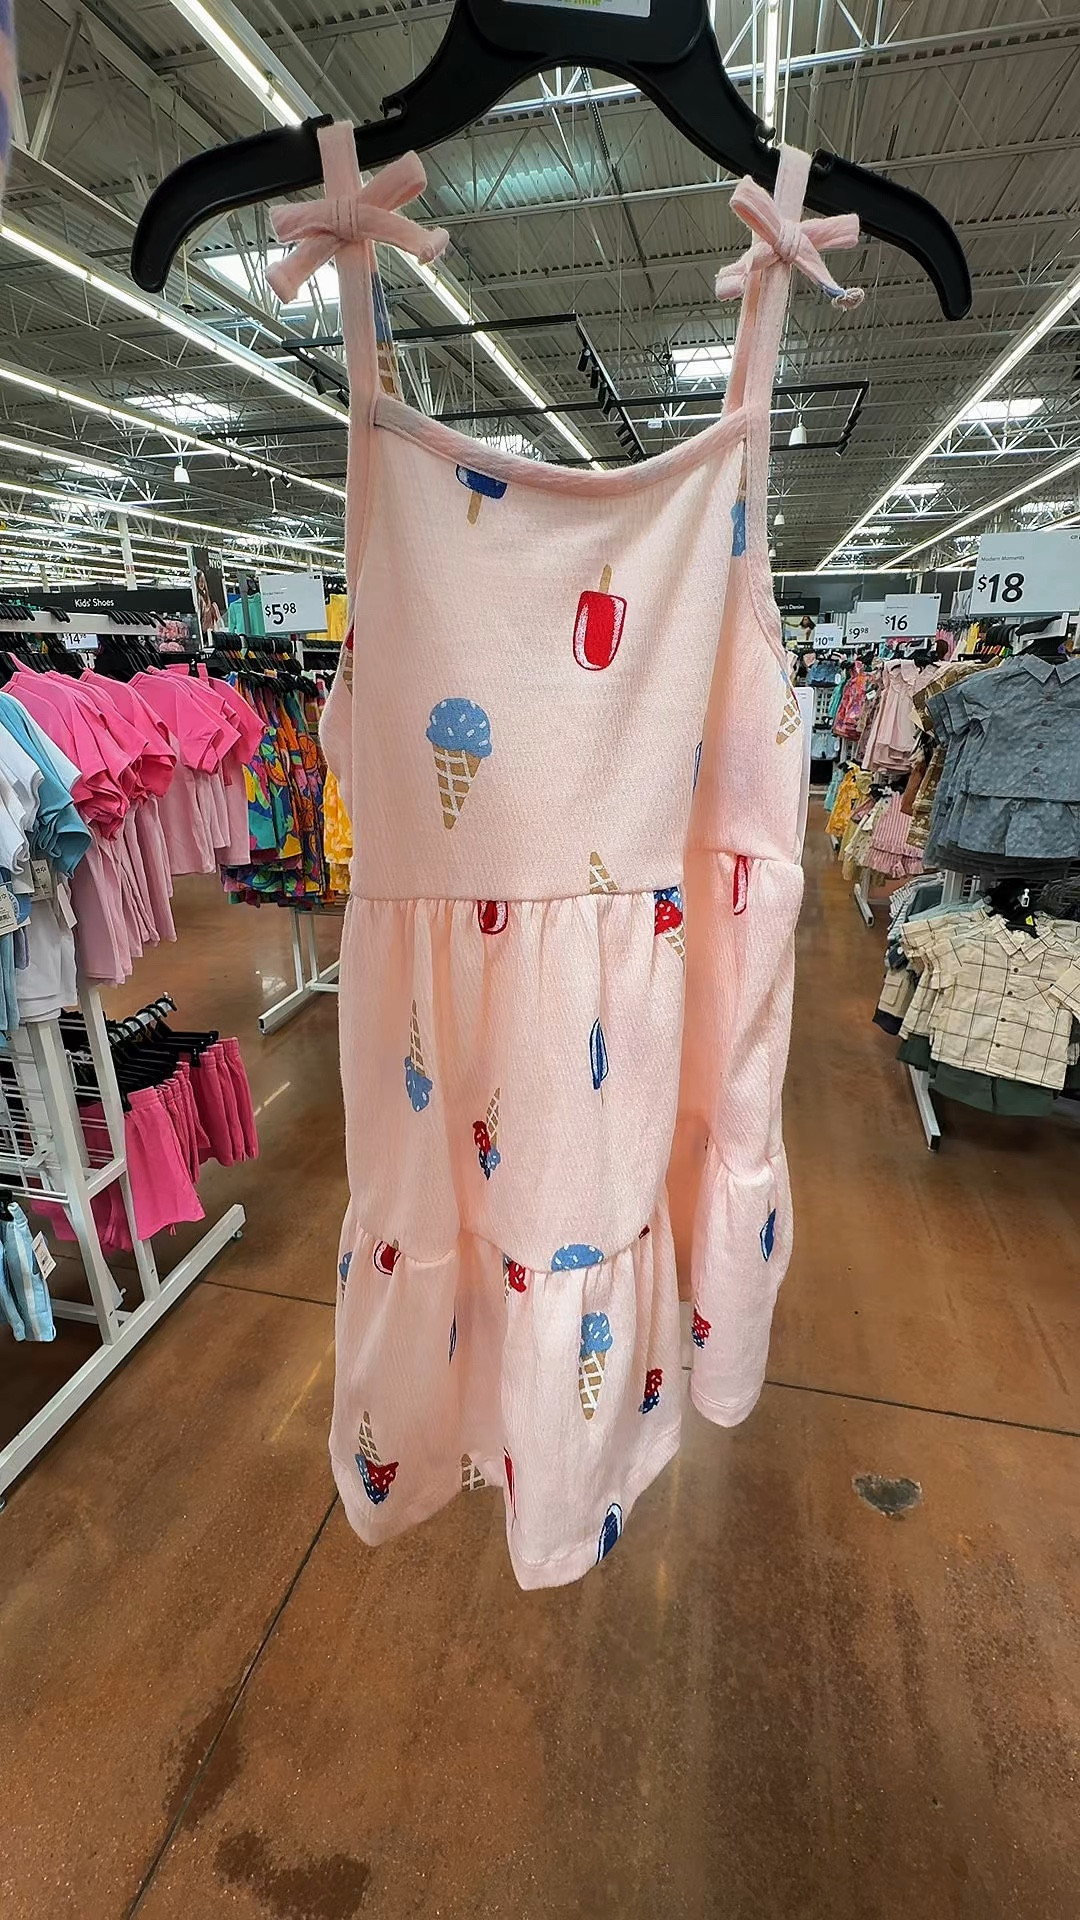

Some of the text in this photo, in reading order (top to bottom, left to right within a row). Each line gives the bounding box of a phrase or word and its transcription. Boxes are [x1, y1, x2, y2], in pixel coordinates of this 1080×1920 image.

[977, 572, 1025, 603] $18
[74, 597, 115, 608] Kids' Shoes
[884, 614, 908, 631] $16
